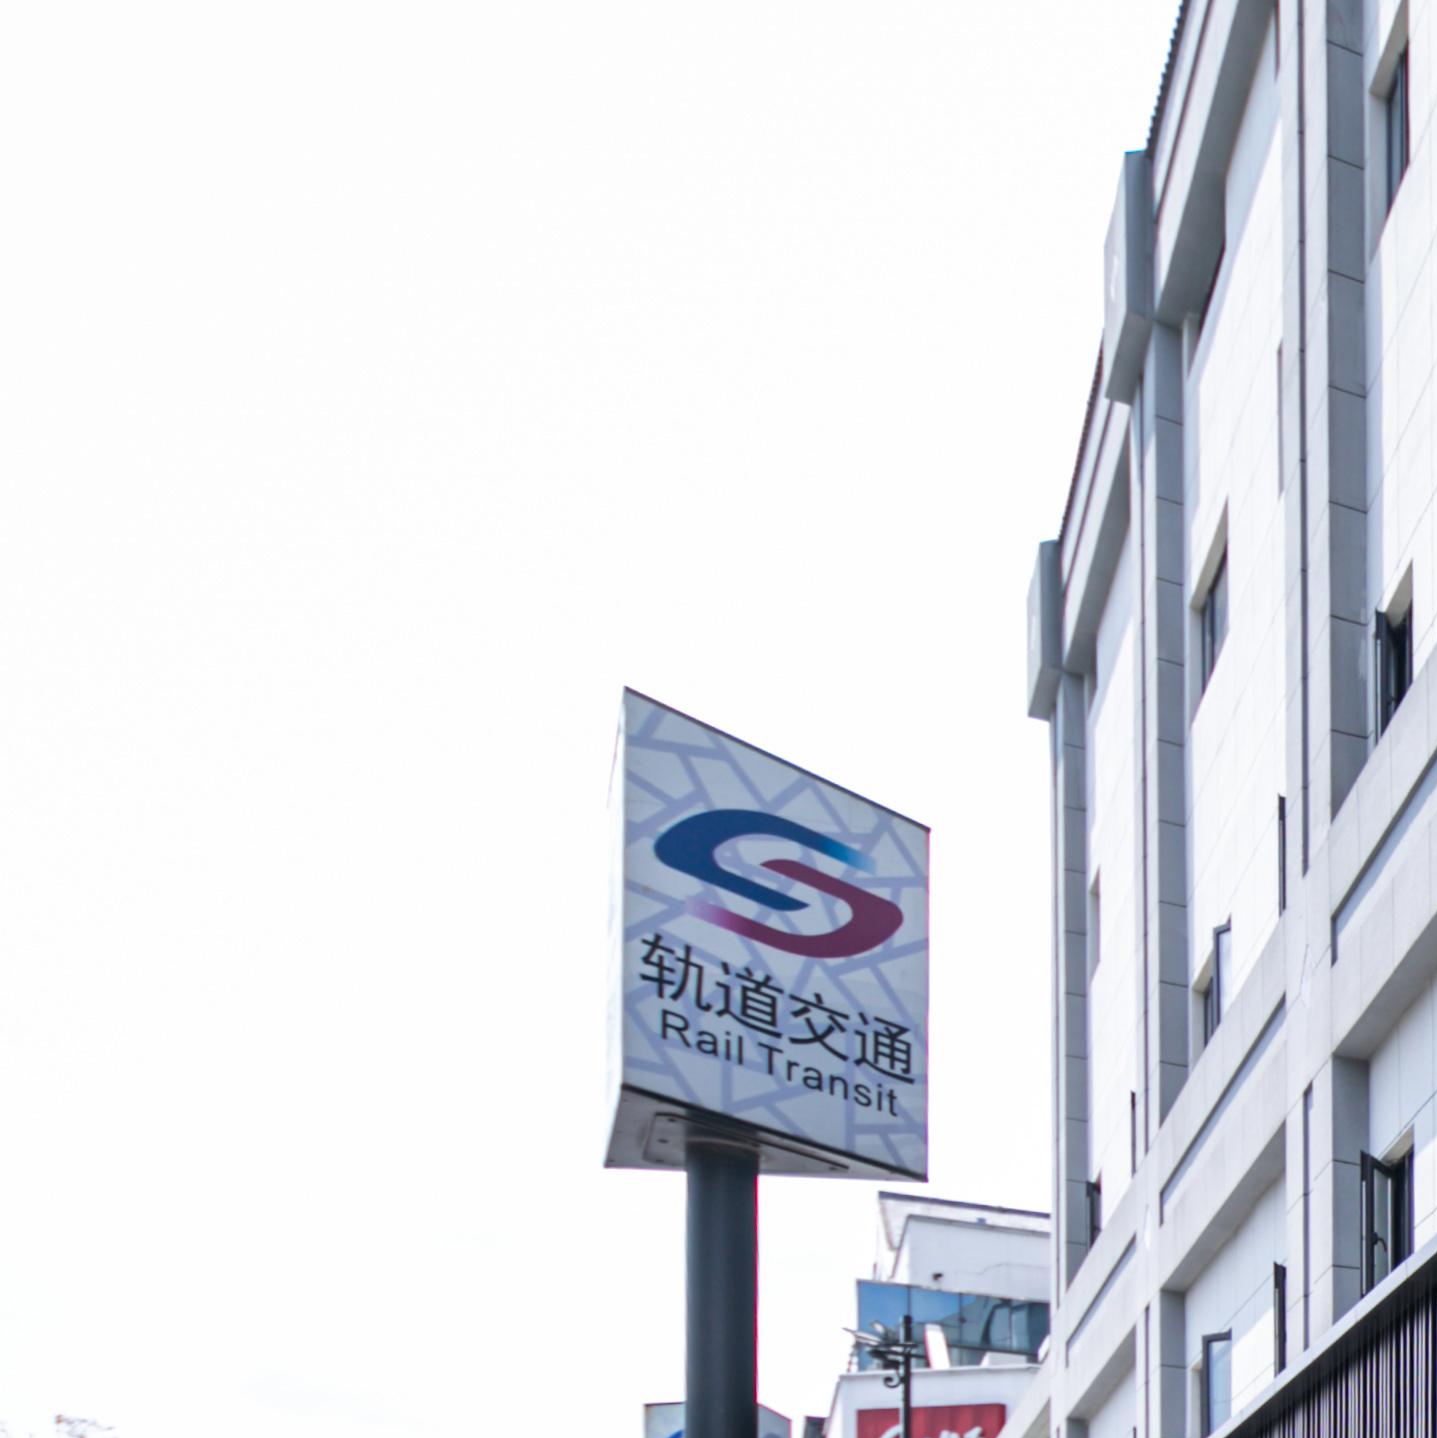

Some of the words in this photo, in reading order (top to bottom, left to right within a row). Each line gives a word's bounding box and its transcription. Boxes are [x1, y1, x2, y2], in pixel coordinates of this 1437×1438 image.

[639, 933, 915, 1085] 轨道交通
[660, 1009, 744, 1066] Rail
[758, 1042, 899, 1117] Transit
